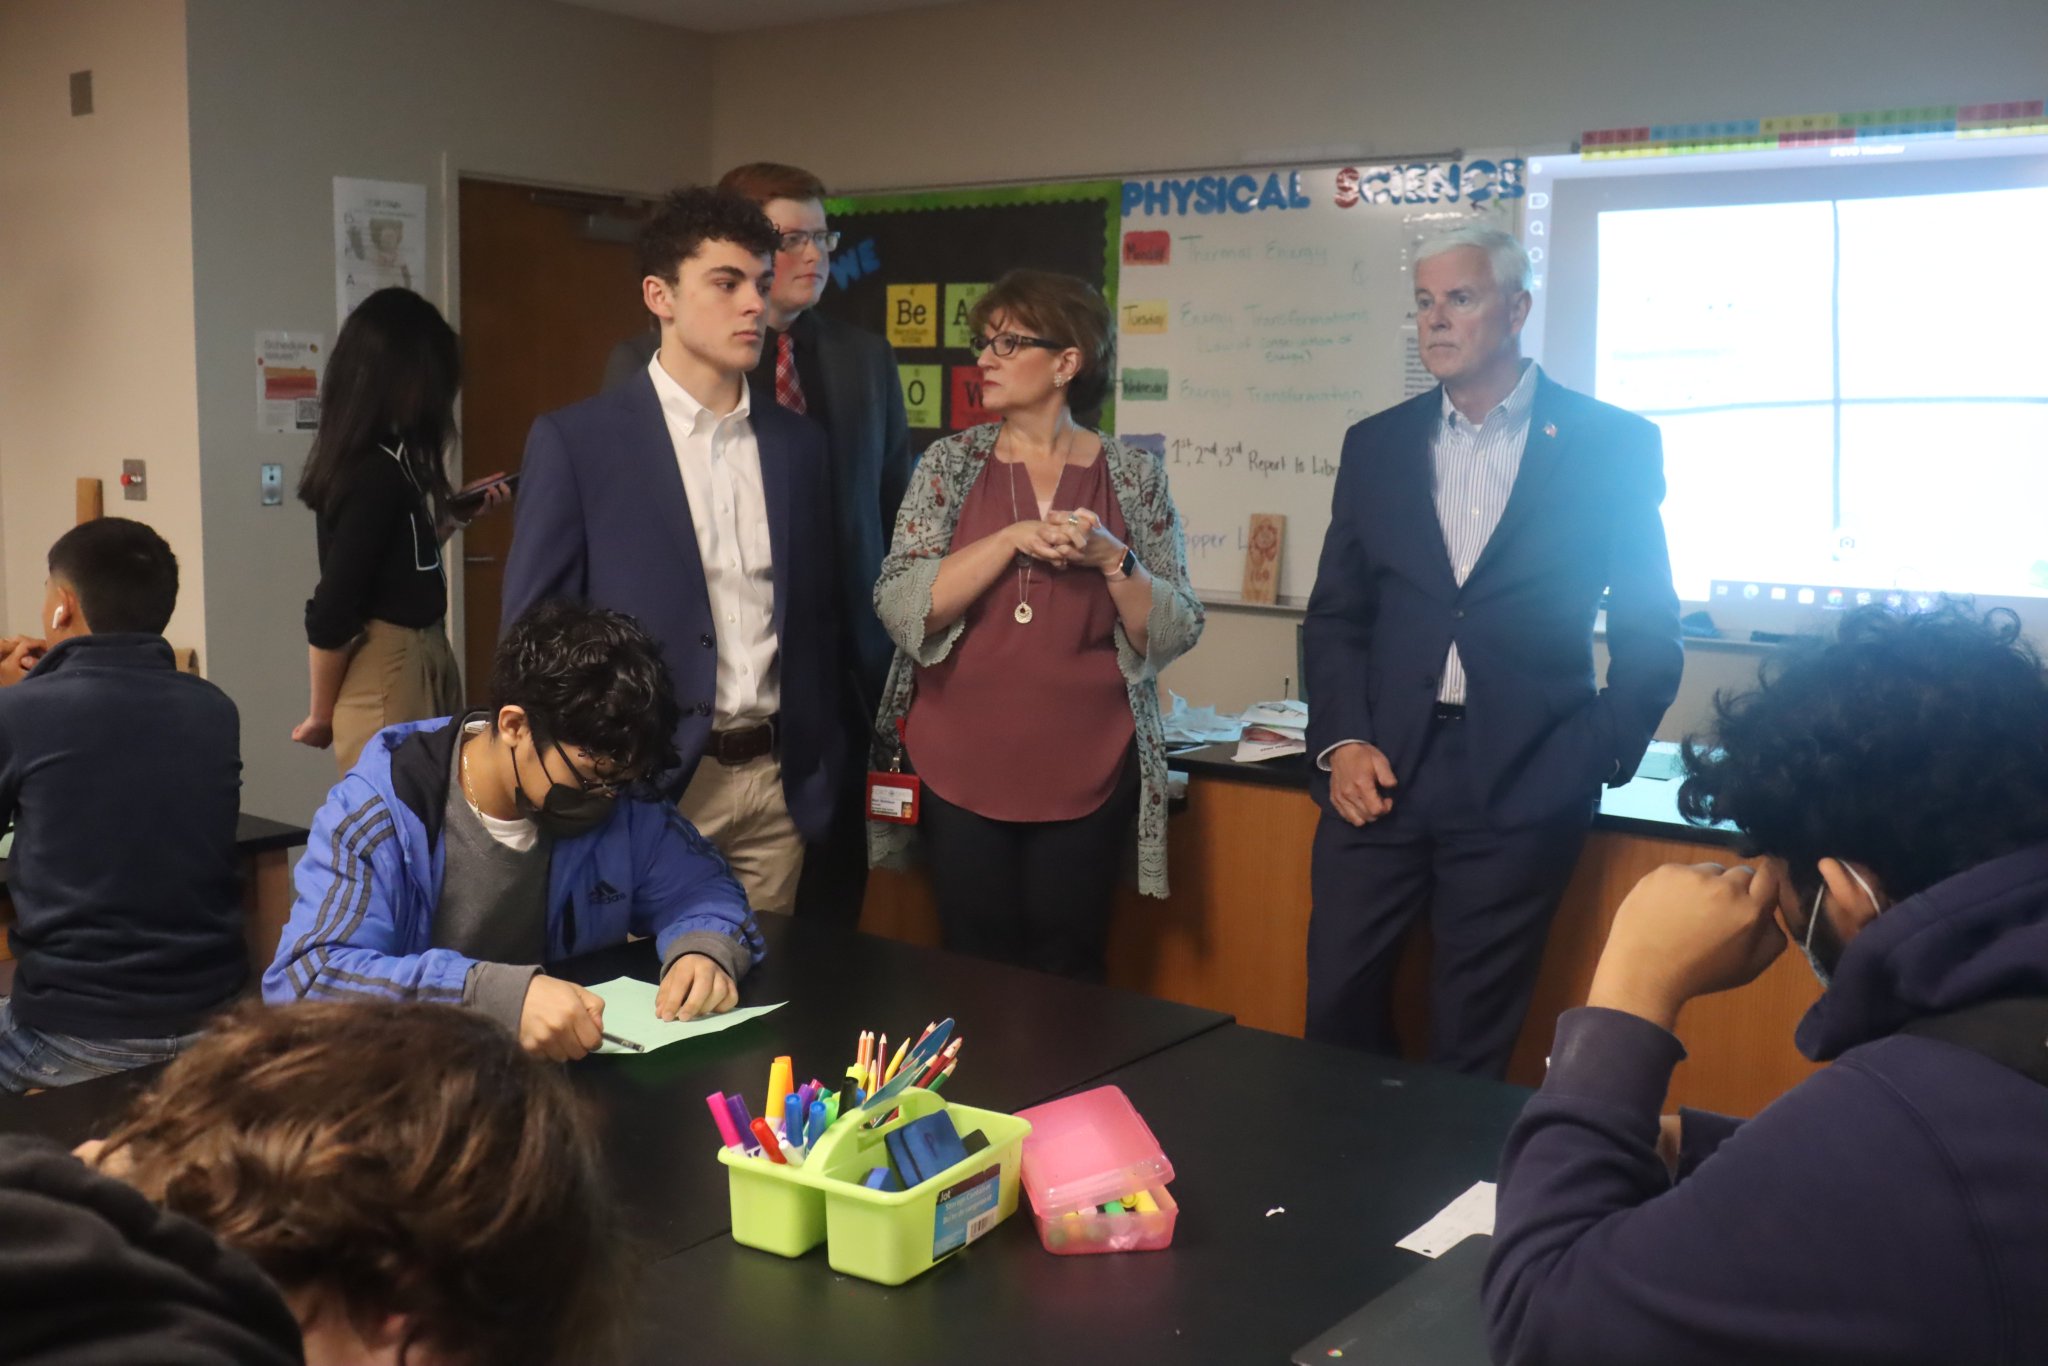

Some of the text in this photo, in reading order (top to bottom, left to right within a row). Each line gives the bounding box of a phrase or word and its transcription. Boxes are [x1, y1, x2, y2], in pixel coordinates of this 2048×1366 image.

[1121, 159, 1525, 217] PHYSICAL SCIENCE
[1265, 241, 1329, 265] Energy
[896, 299, 927, 326] Be
[953, 299, 969, 326] A
[1179, 302, 1233, 328] Energy
[908, 380, 925, 406] O
[1249, 449, 1286, 477] Report
[1313, 456, 1338, 475] Libr
[1184, 532, 1227, 558] opper
